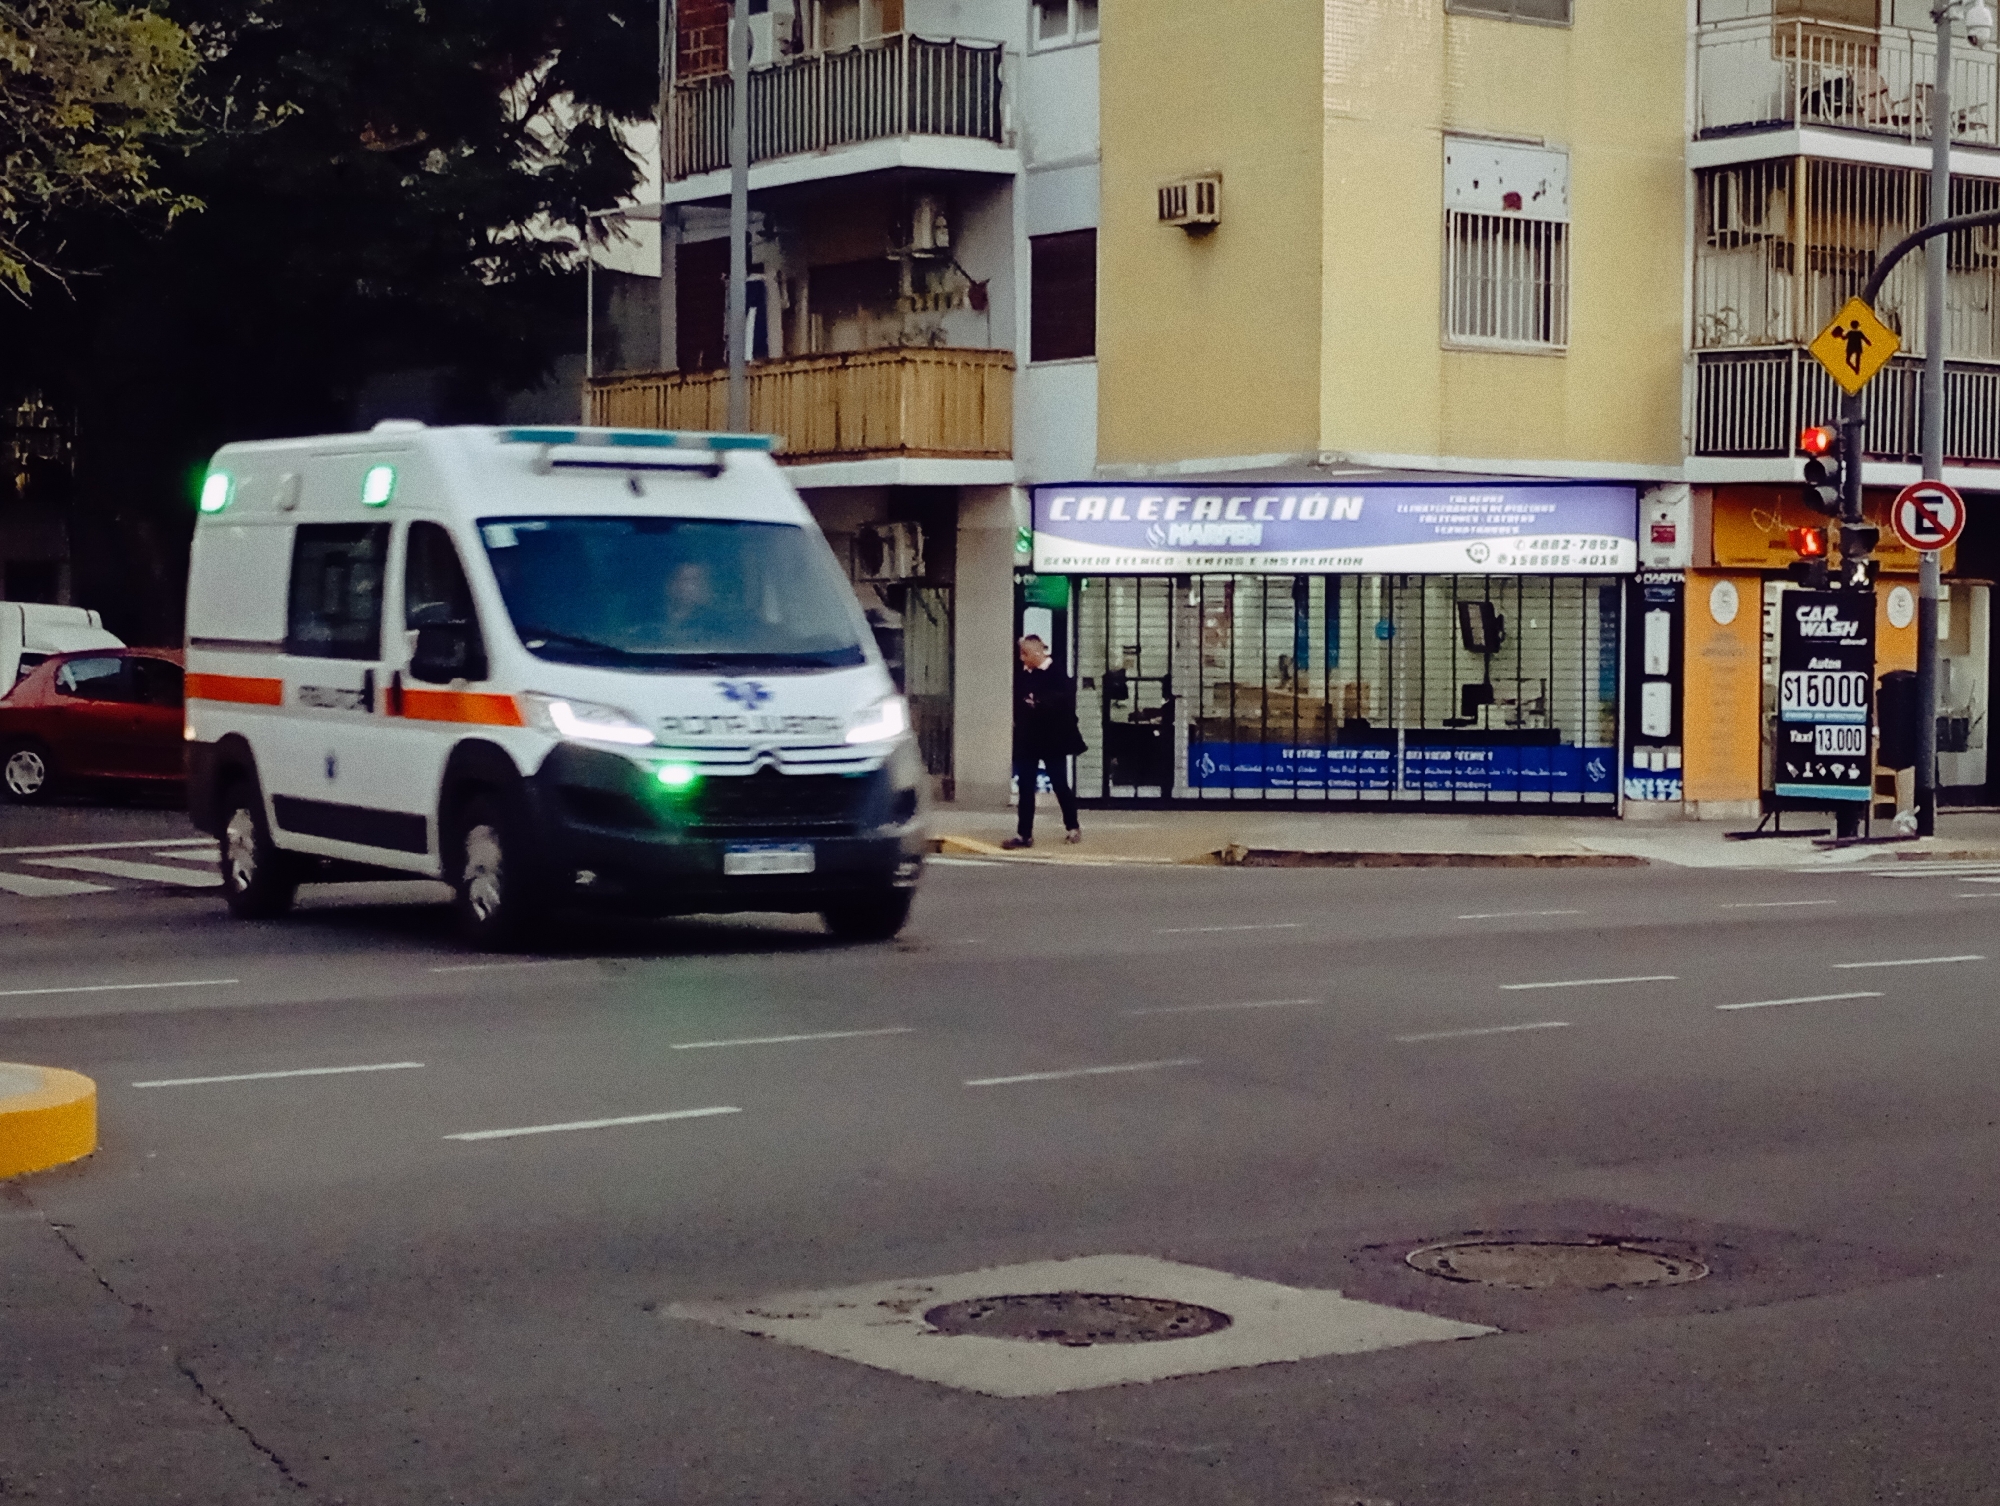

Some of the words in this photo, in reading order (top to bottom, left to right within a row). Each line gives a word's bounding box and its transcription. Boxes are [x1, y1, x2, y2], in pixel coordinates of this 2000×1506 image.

[1796, 605, 1838, 621] CAR
[1800, 621, 1859, 637] WASH
[1818, 728, 1862, 752] 13.000
